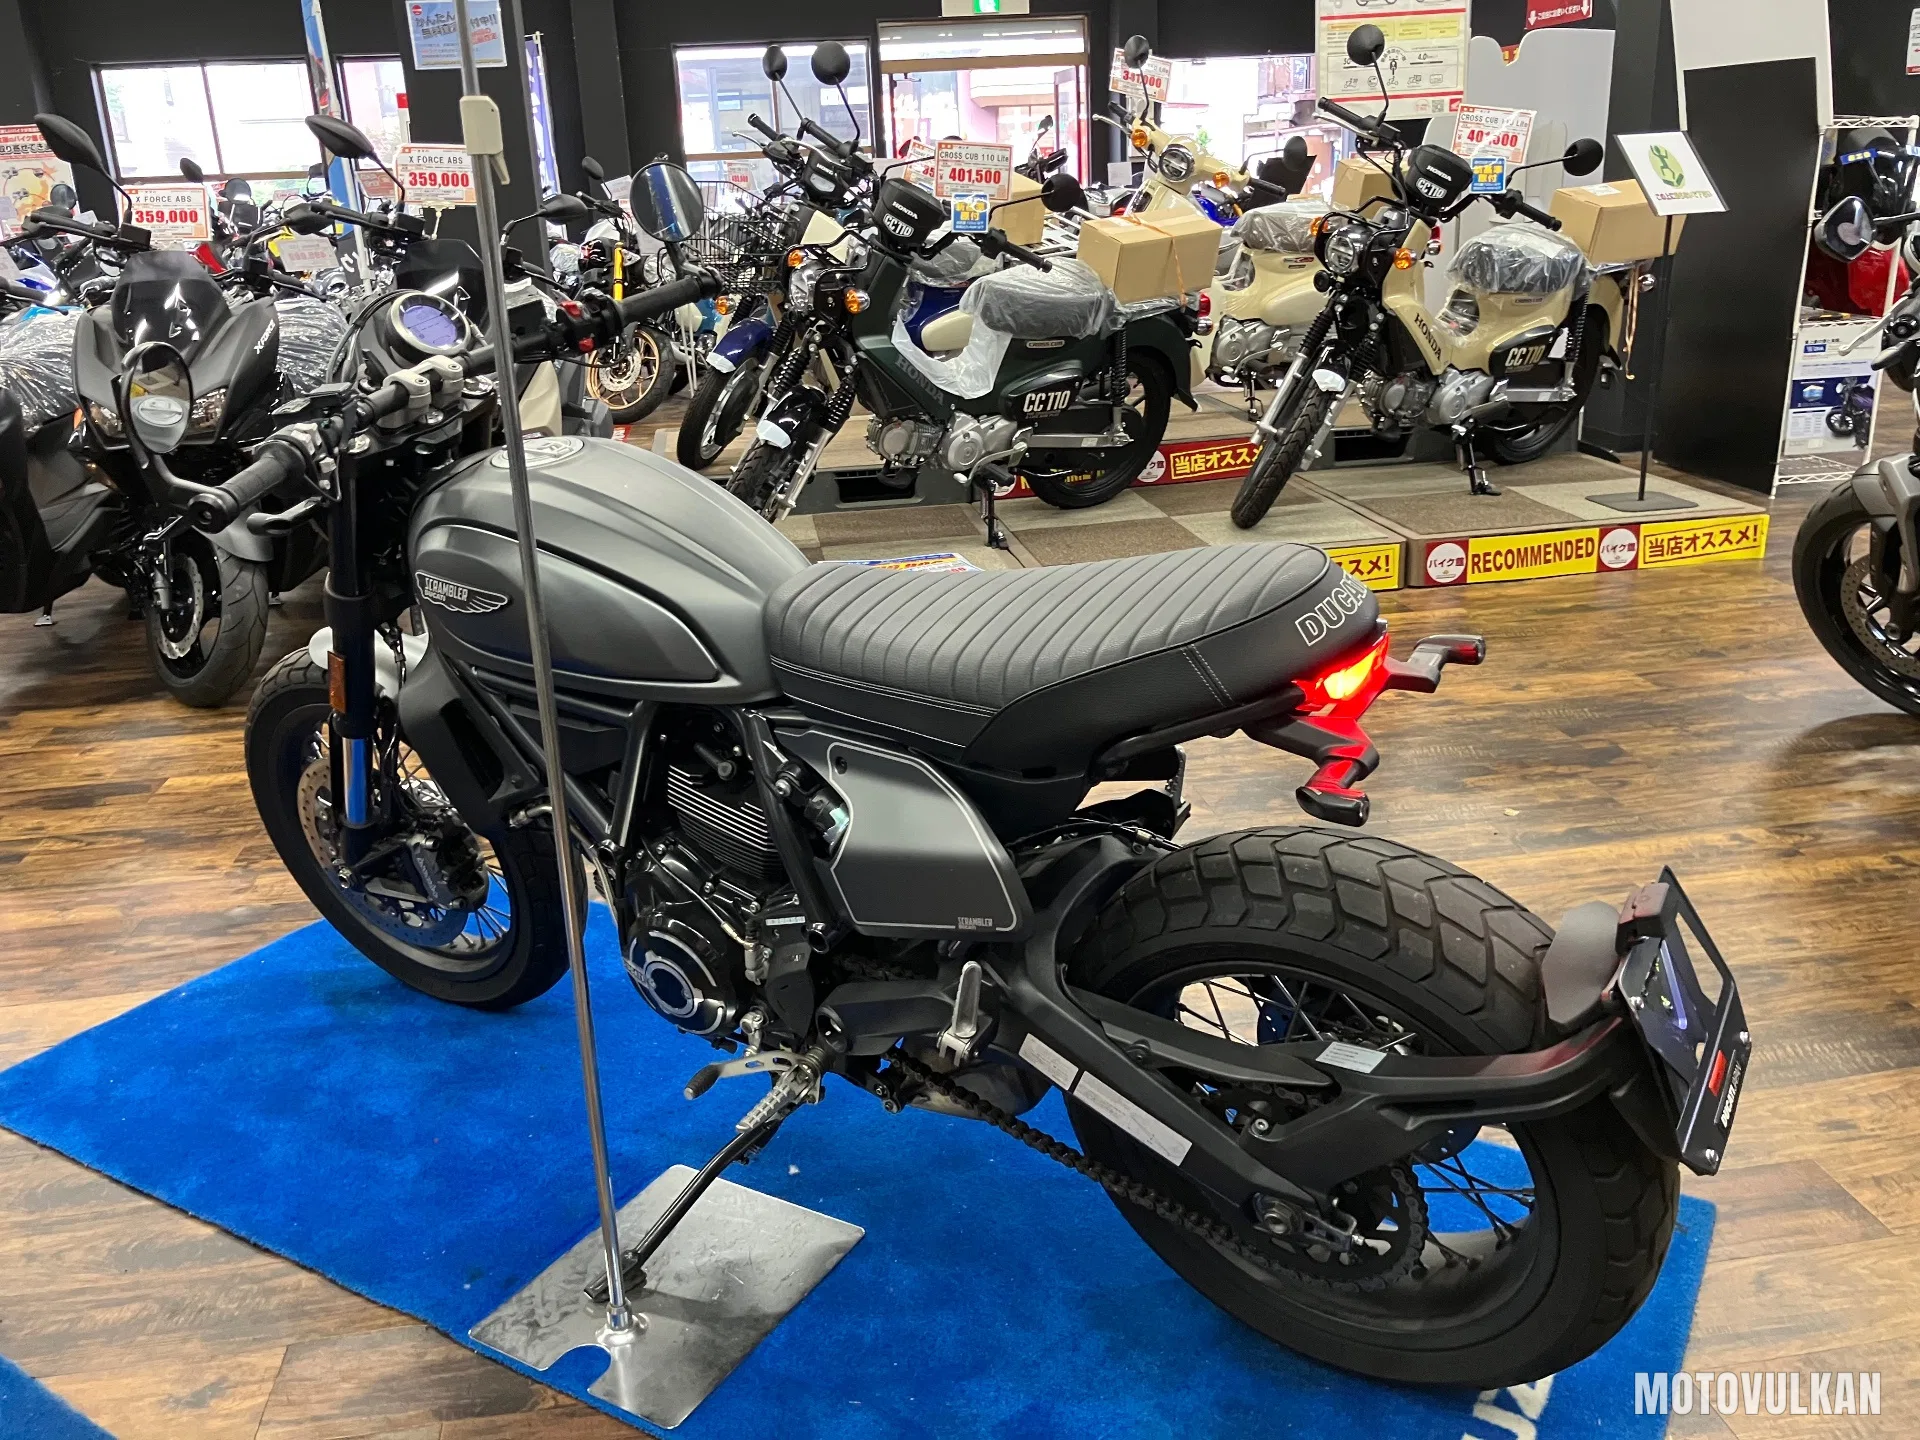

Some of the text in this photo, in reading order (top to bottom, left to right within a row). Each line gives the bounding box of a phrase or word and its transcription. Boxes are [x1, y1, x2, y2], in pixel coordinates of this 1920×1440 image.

[1461, 113, 1483, 122] CROSS
[1485, 116, 1499, 124] CUB
[417, 156, 444, 164] FORCE
[940, 151, 1009, 163] CROSS CUB 110 Lite
[408, 172, 470, 188] 359,000
[948, 167, 1002, 184] 401,500
[1426, 164, 1452, 182] HONDA
[144, 195, 172, 203] FORCE
[175, 195, 192, 203] ABS
[135, 210, 198, 224] 359,000
[892, 201, 919, 220] HONDA
[253, 319, 276, 355] X FORCE
[1414, 312, 1442, 360] HONDA
[1174, 445, 1263, 476] 当店オススメ
[1648, 524, 1759, 559] 当店オススメ!
[1471, 536, 1596, 575] RECOMMENDED
[424, 577, 469, 602] SCRAMBLER
[424, 589, 446, 602] DUCATI
[957, 916, 993, 927] SCRAMBLER
[1720, 1084, 1737, 1129] DUCATI
